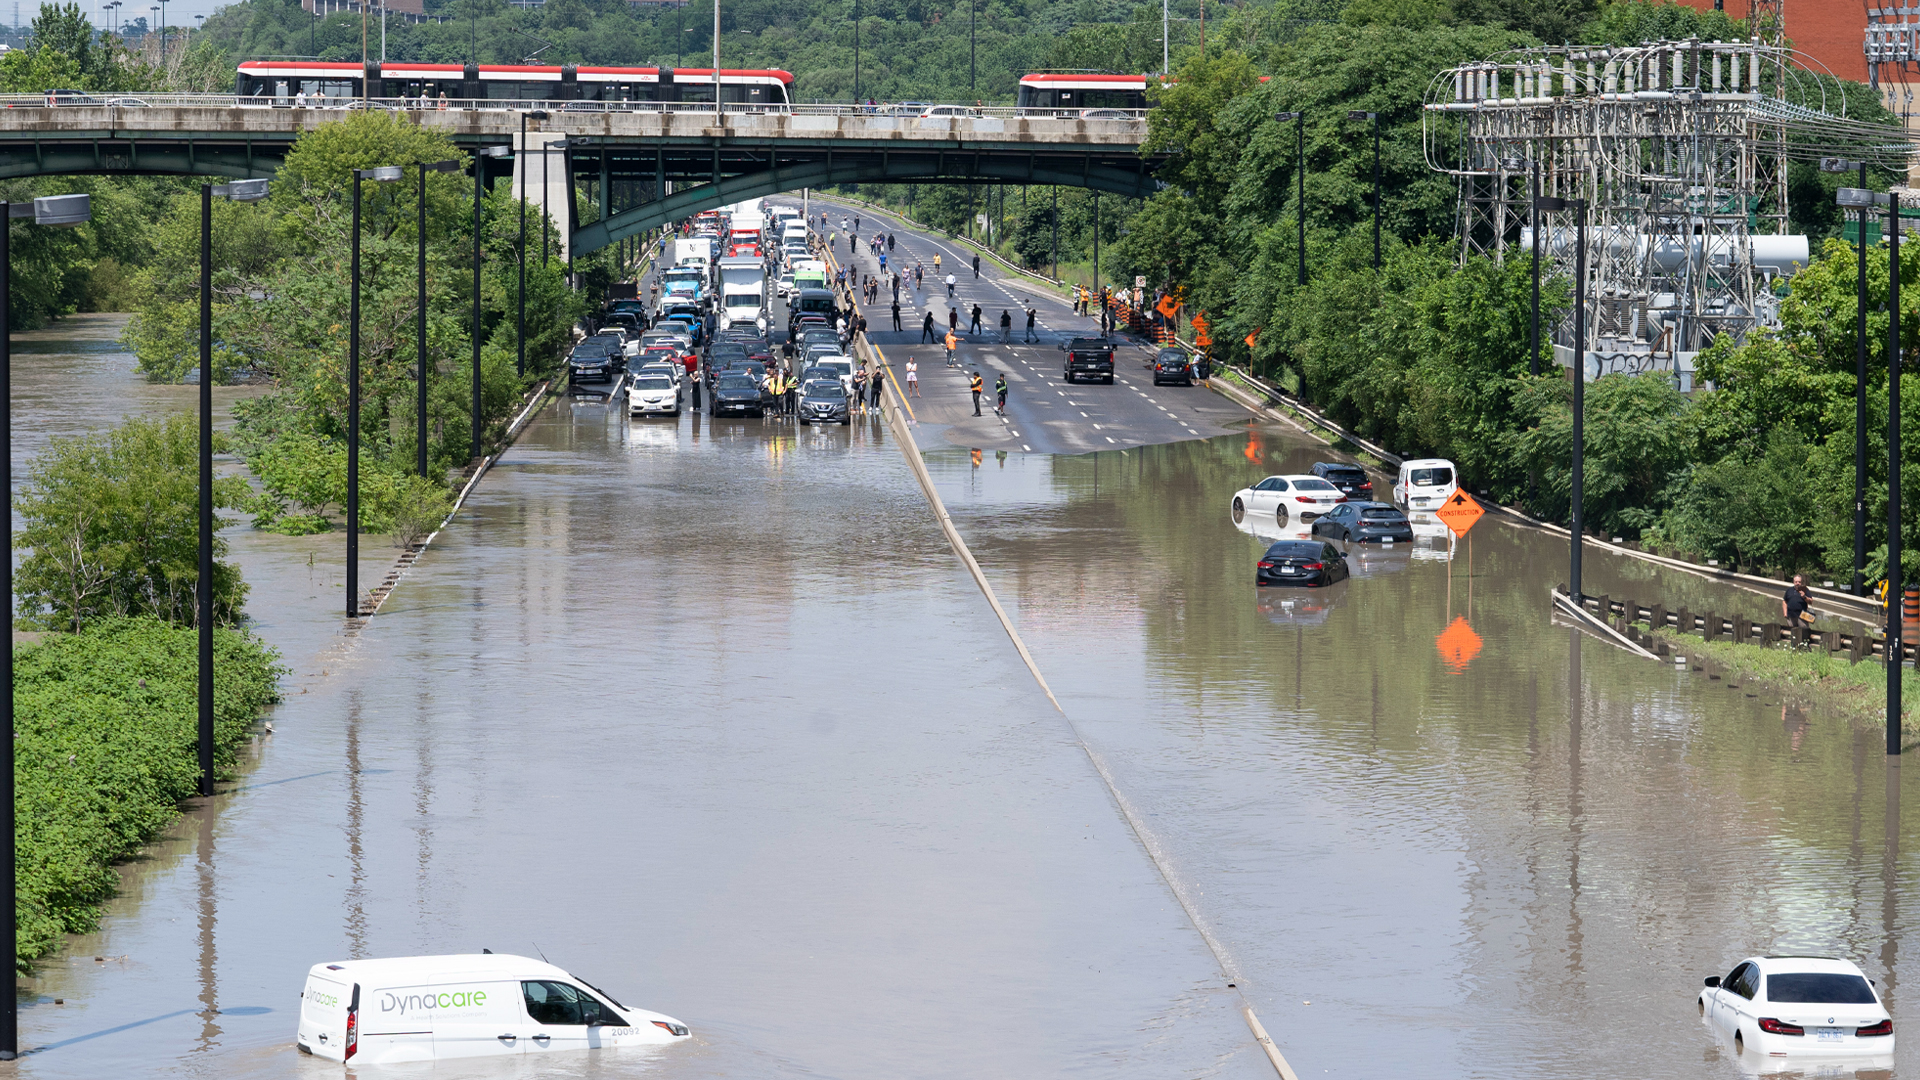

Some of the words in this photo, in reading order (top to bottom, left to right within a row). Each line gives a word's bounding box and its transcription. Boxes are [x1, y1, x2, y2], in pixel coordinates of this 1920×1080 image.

[1440, 509, 1480, 517] CONSTRUCTION
[381, 990, 487, 1016] Dynacare
[611, 1027, 640, 1037] 20092
